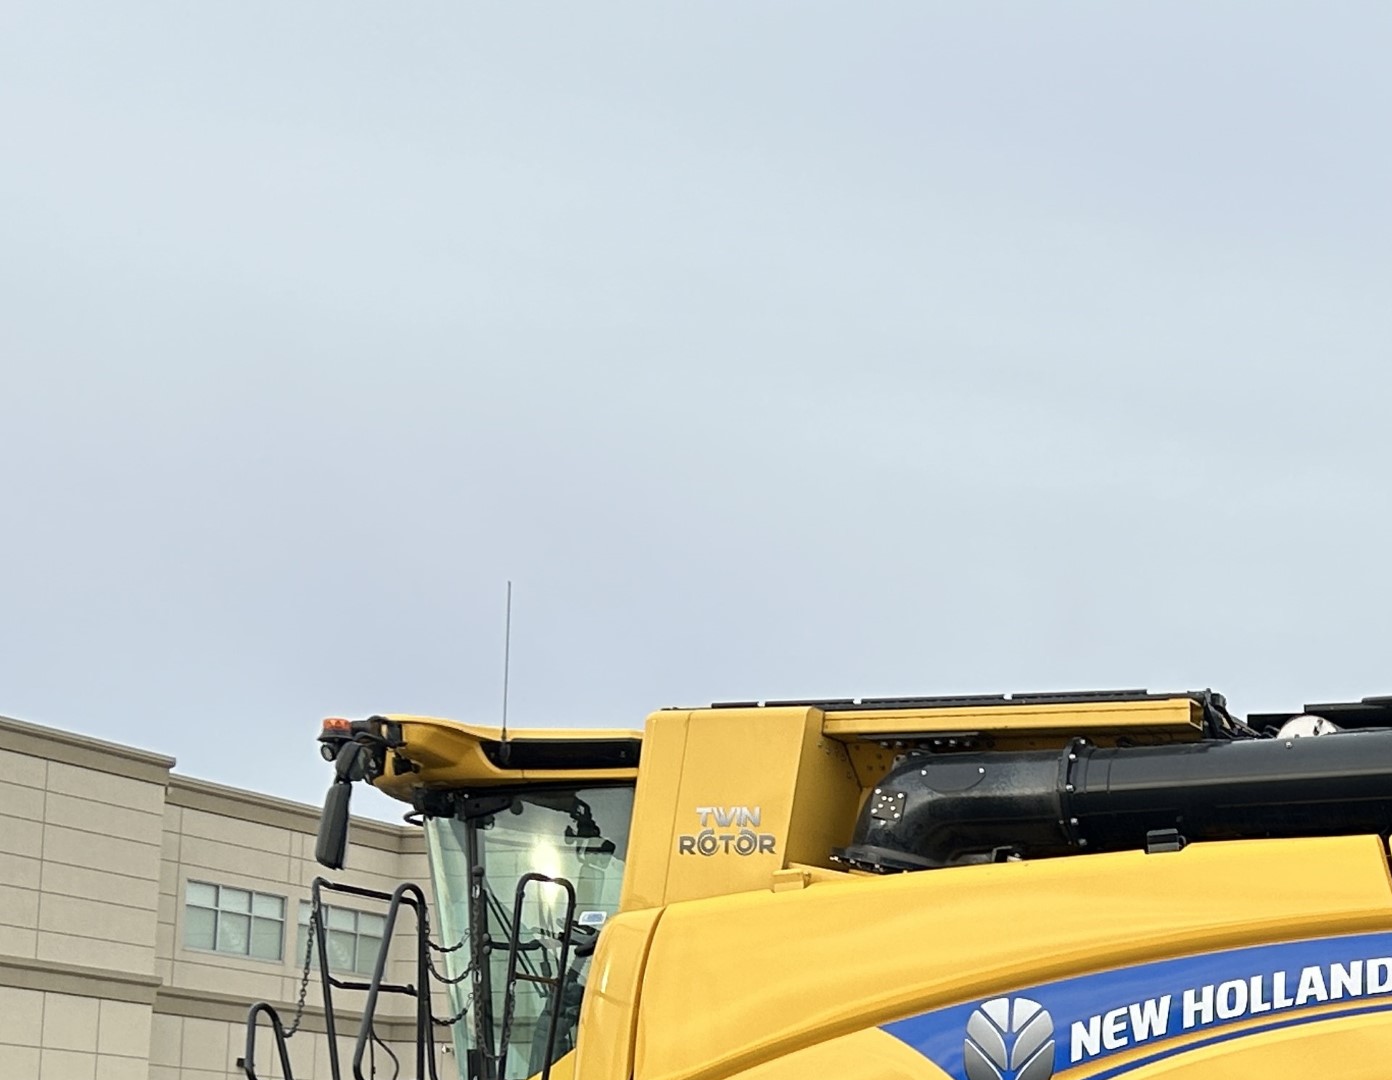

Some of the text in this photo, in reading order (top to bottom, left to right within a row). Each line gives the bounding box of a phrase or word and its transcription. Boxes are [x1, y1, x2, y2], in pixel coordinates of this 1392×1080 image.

[696, 806, 761, 827] TWIN
[679, 828, 777, 856] ROTOR
[1070, 995, 1172, 1063] NEW
